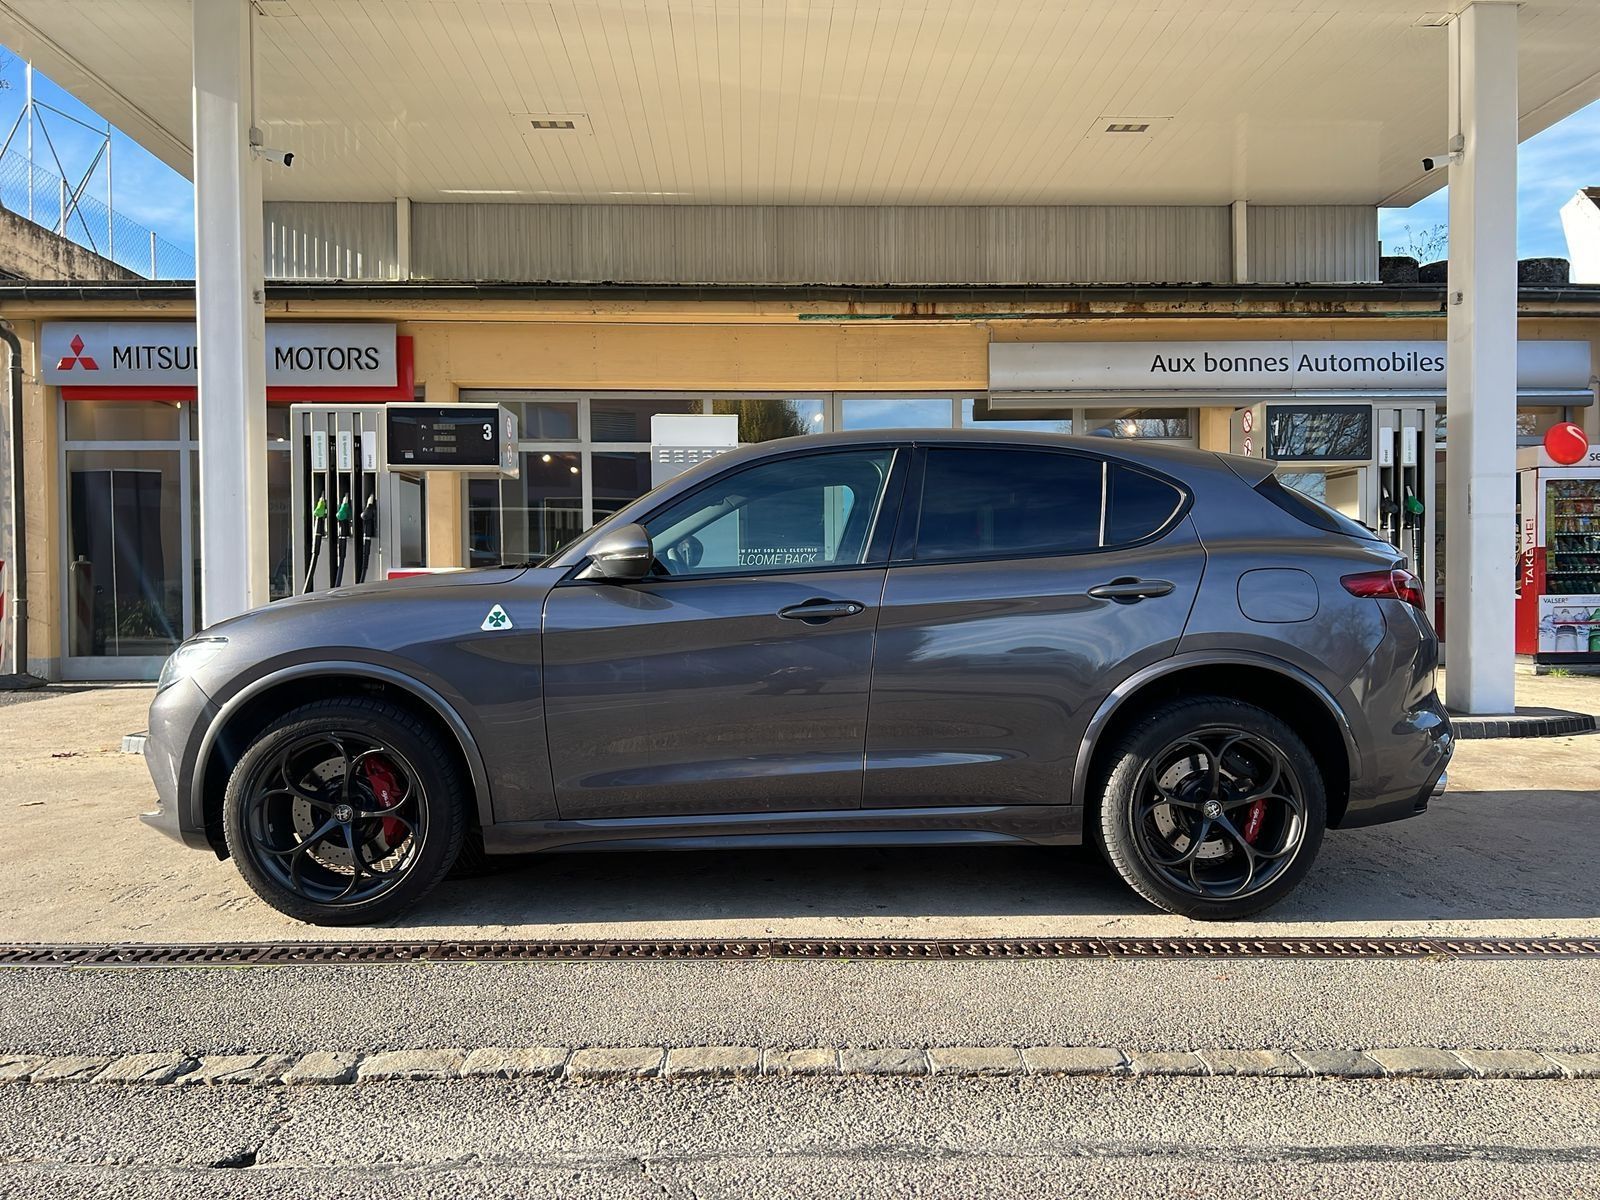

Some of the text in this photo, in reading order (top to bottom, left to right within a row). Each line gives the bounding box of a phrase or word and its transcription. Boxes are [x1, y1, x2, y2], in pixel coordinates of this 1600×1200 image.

[112, 346, 380, 370] MITSU MOTORS
[1150, 352, 1444, 372] Aux bonnes Automobiles
[482, 423, 493, 440] 3
[1273, 420, 1279, 436] 1
[1525, 518, 1534, 586] TAKE ME!
